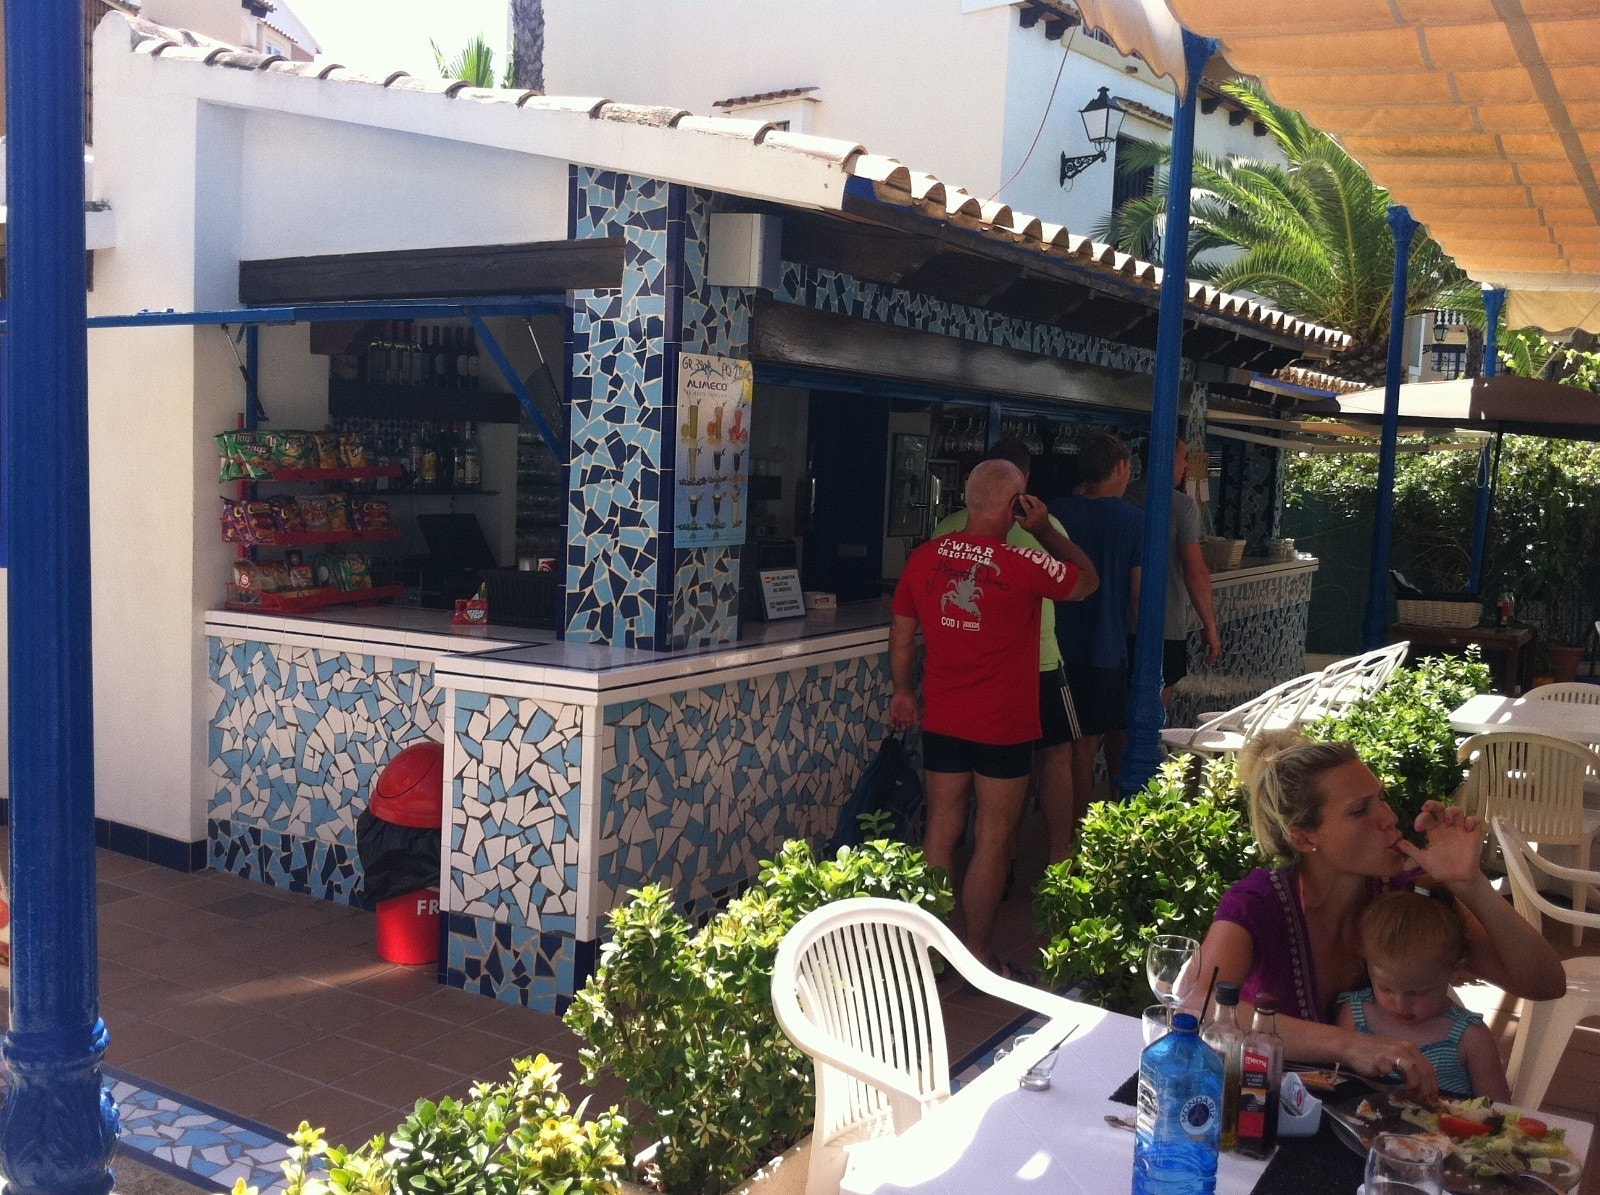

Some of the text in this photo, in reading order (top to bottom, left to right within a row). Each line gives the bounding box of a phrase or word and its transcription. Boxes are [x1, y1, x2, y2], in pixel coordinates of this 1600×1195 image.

[687, 380, 728, 391] ALIMECO
[937, 547, 991, 565] ORIGINALS
[940, 538, 994, 558] J-WEAR
